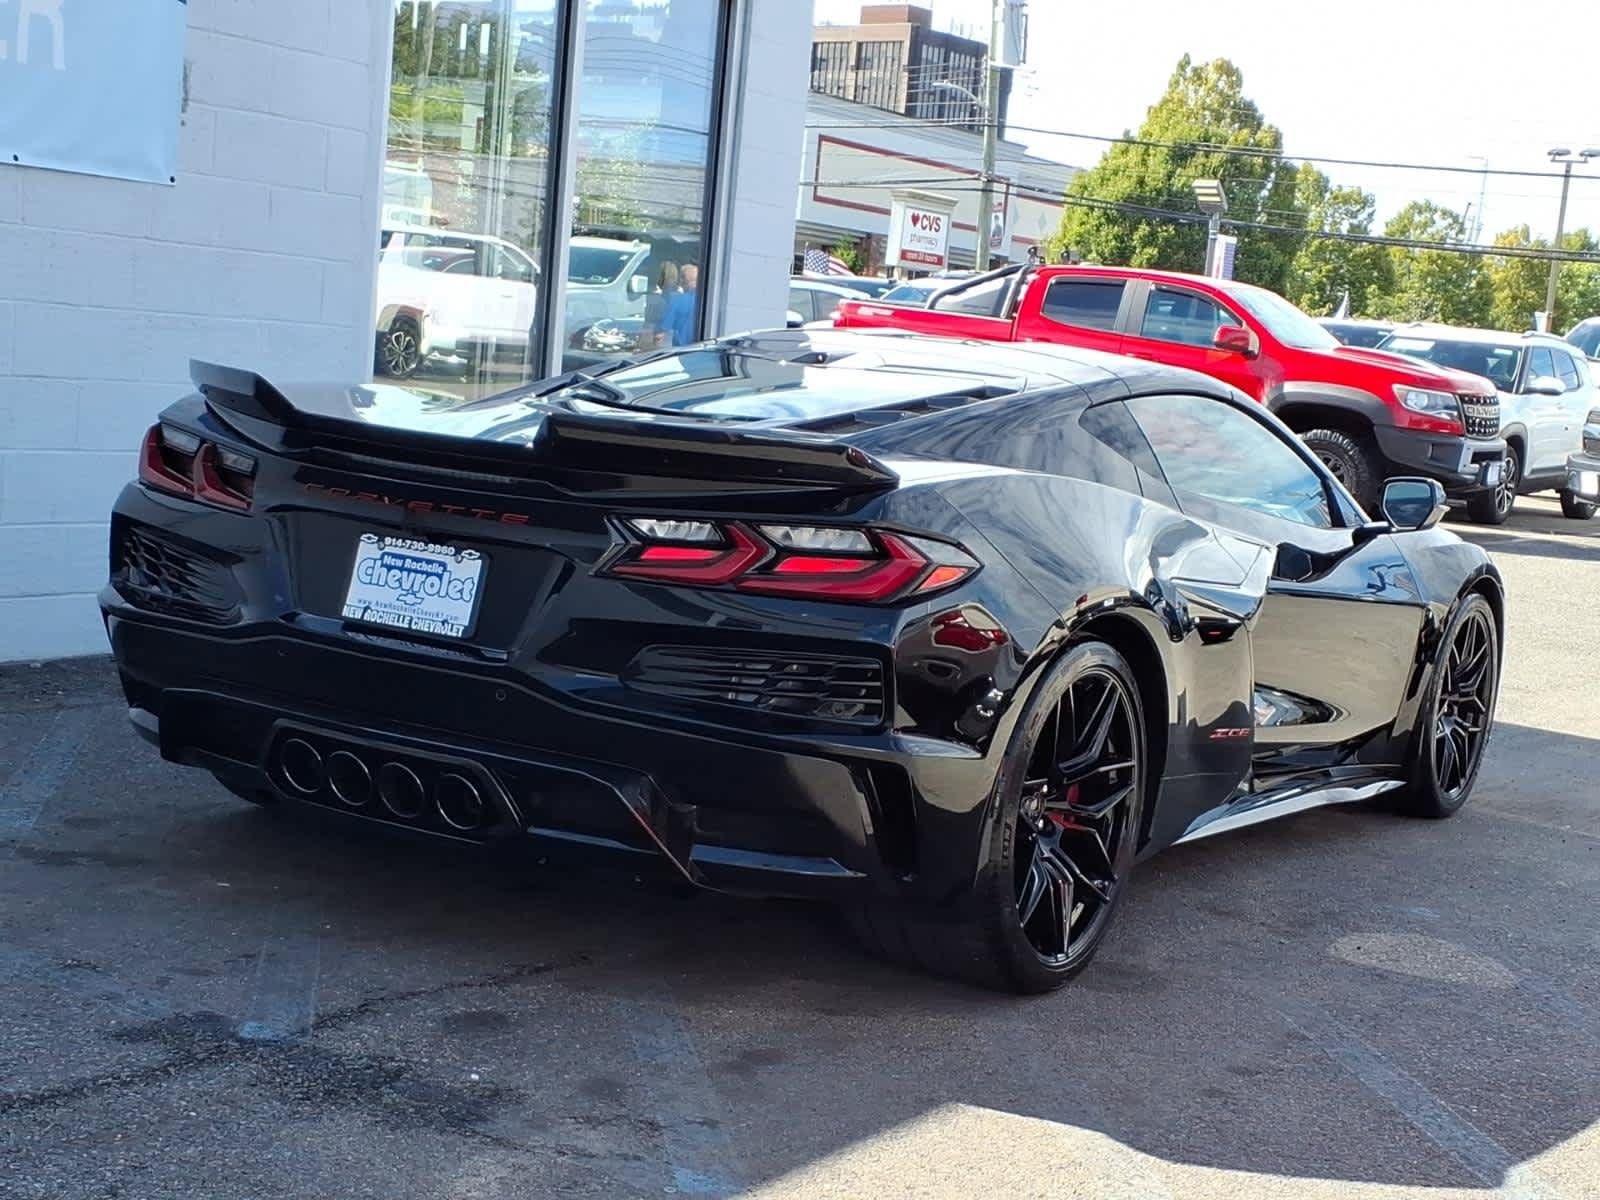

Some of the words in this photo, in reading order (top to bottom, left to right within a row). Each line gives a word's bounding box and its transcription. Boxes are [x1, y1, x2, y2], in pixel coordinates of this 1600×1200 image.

[920, 214, 942, 232] CVS
[304, 483, 529, 525] CORVETTE
[357, 557, 475, 603] Chevrolet
[383, 555, 404, 567] New
[404, 558, 444, 574] Rochelle
[342, 605, 363, 619] NEW
[363, 608, 411, 628] ROCHELLE
[411, 617, 465, 637] CHEVROLET
